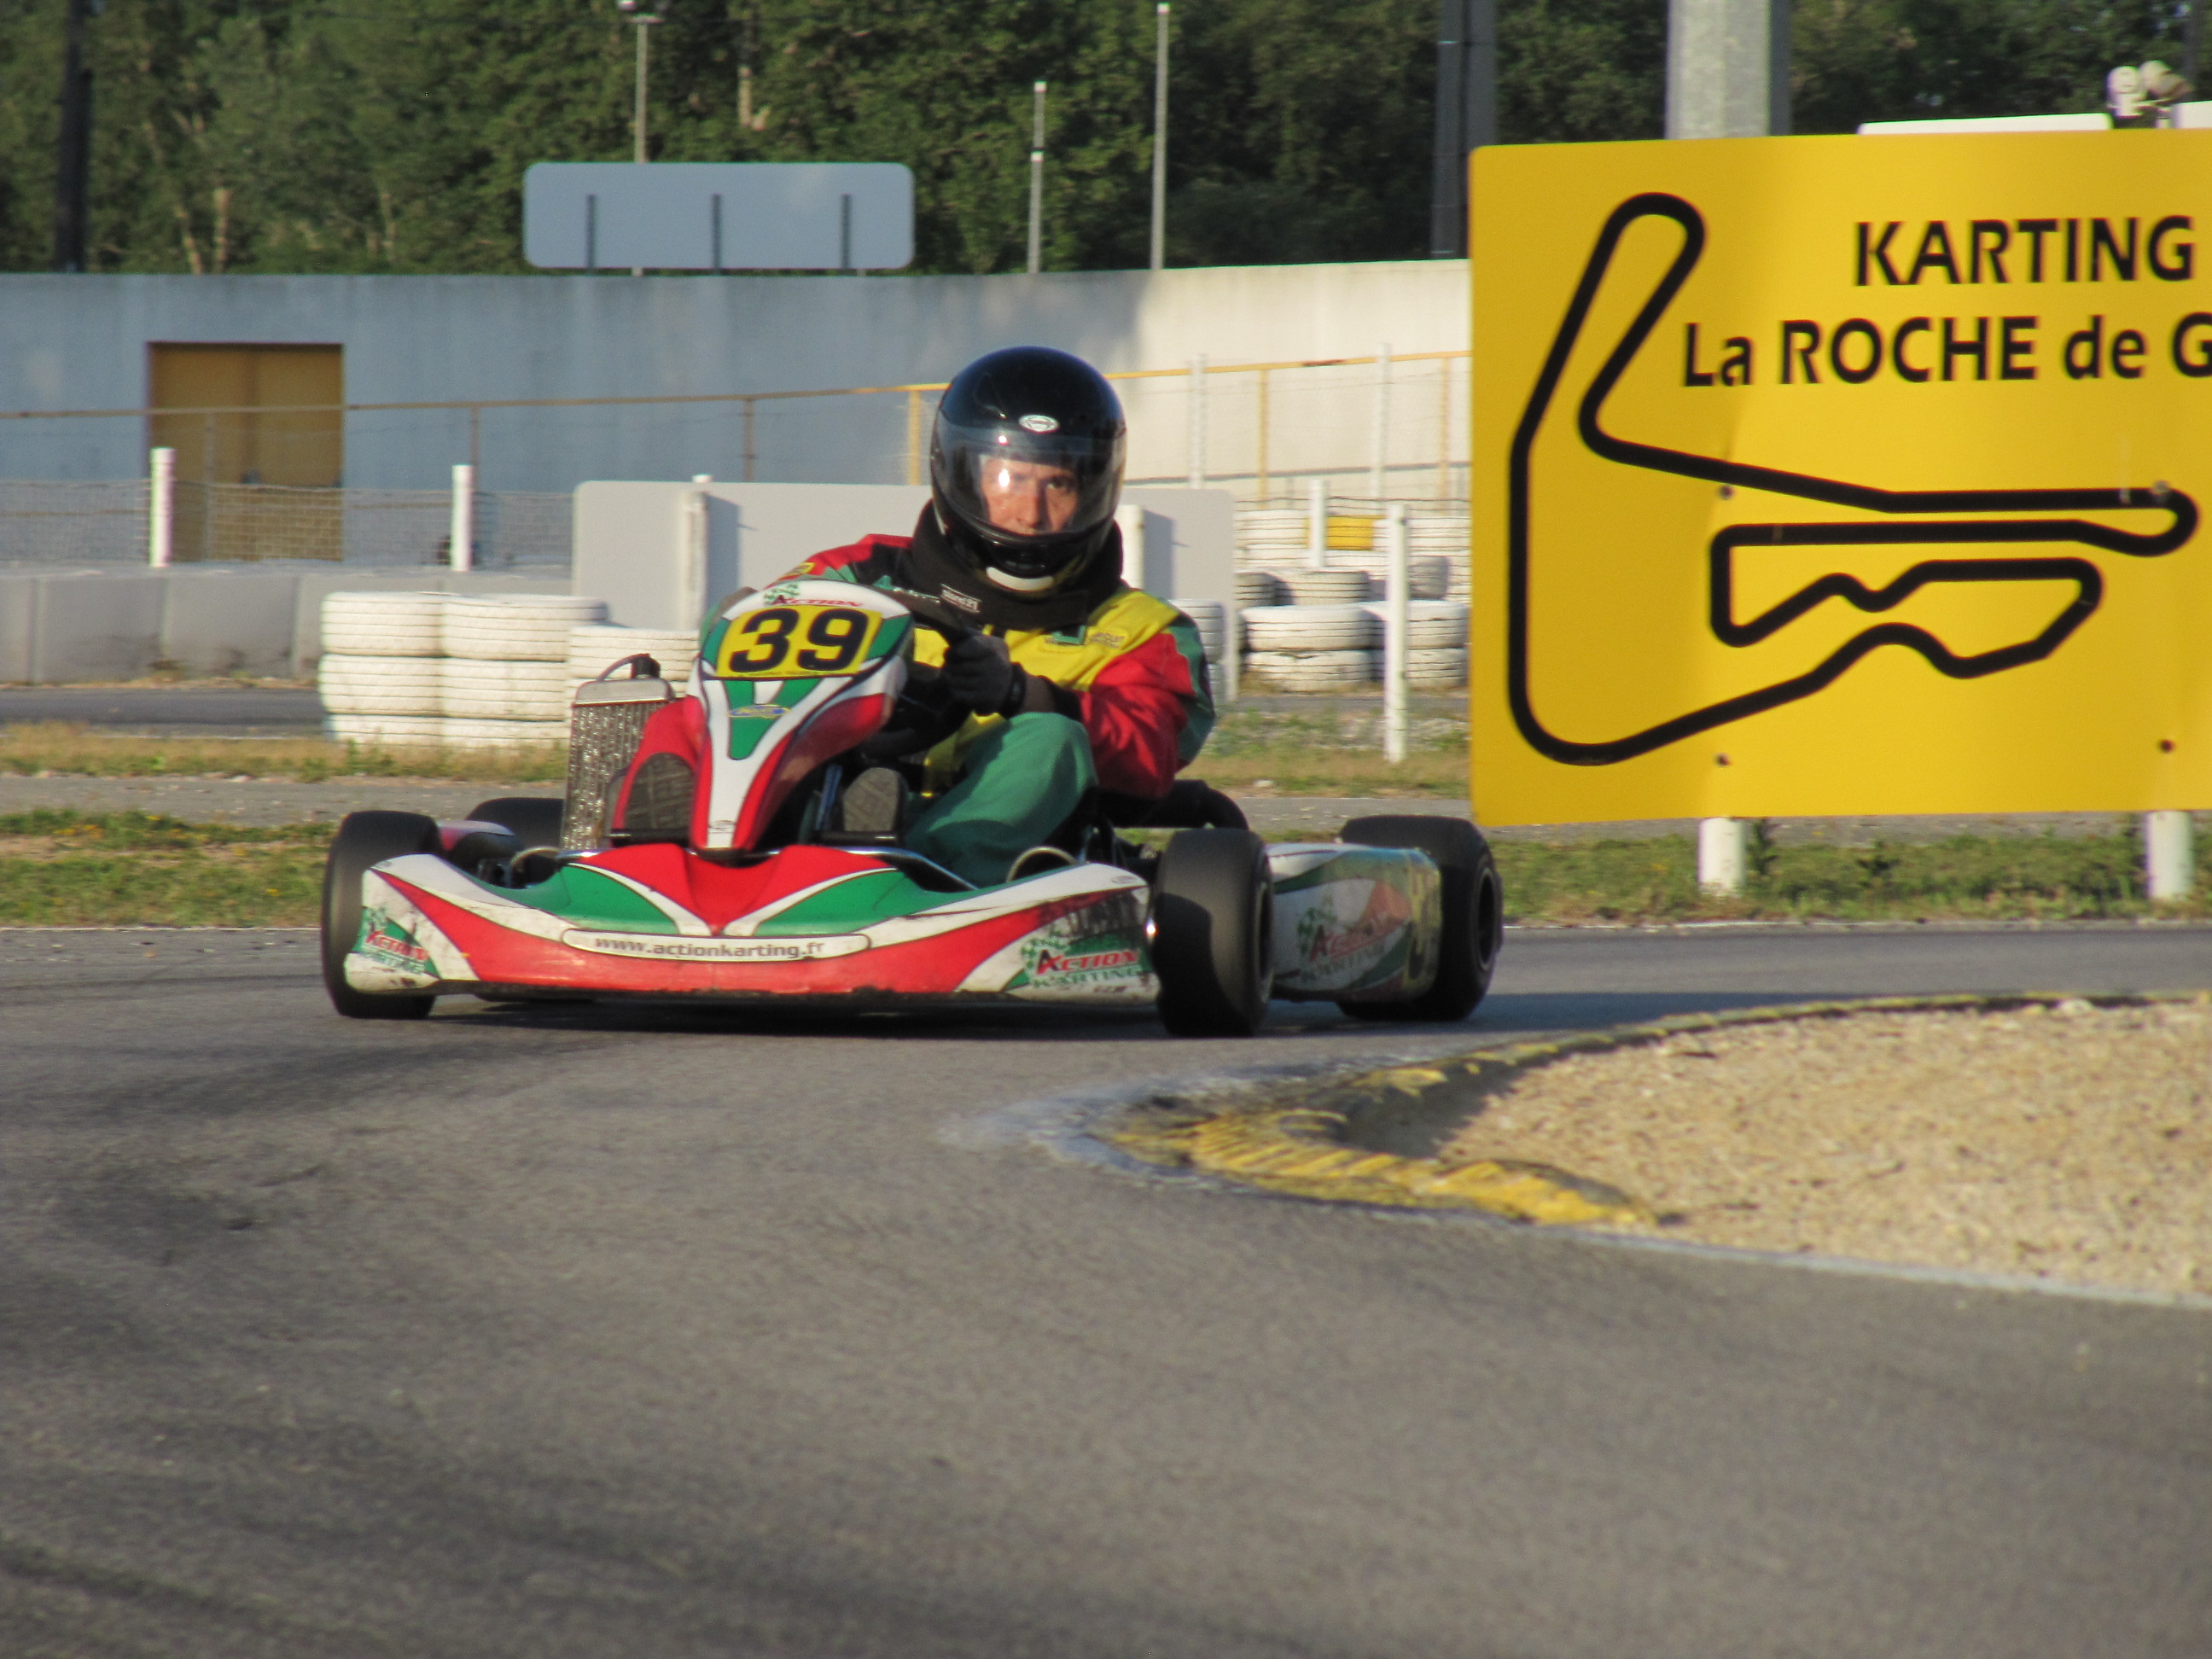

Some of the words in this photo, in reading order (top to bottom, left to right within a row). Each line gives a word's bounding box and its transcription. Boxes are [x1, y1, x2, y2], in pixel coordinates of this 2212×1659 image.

[1854, 215, 2195, 286] KARTING
[1682, 321, 1754, 387] La
[1780, 316, 2040, 386] ROCHE
[2064, 314, 2147, 381] de
[730, 608, 869, 673] 39
[595, 938, 824, 958] www.actionkarting.fr
